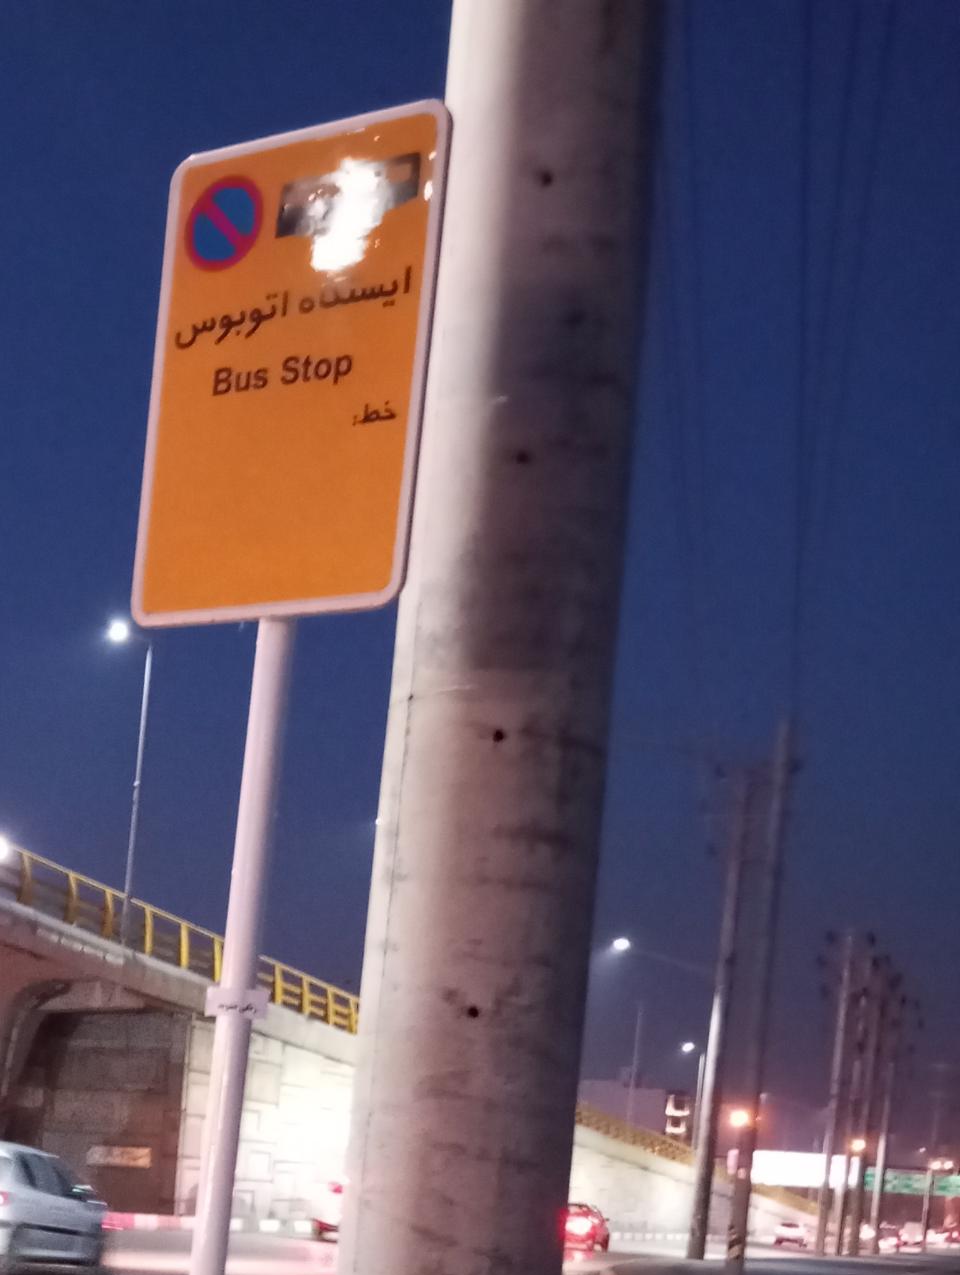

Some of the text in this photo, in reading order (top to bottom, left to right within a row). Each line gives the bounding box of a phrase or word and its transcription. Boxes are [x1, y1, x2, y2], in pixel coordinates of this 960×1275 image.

[175, 265, 411, 349] ایساه اتوبوس
[212, 355, 353, 396] Bus Stop
